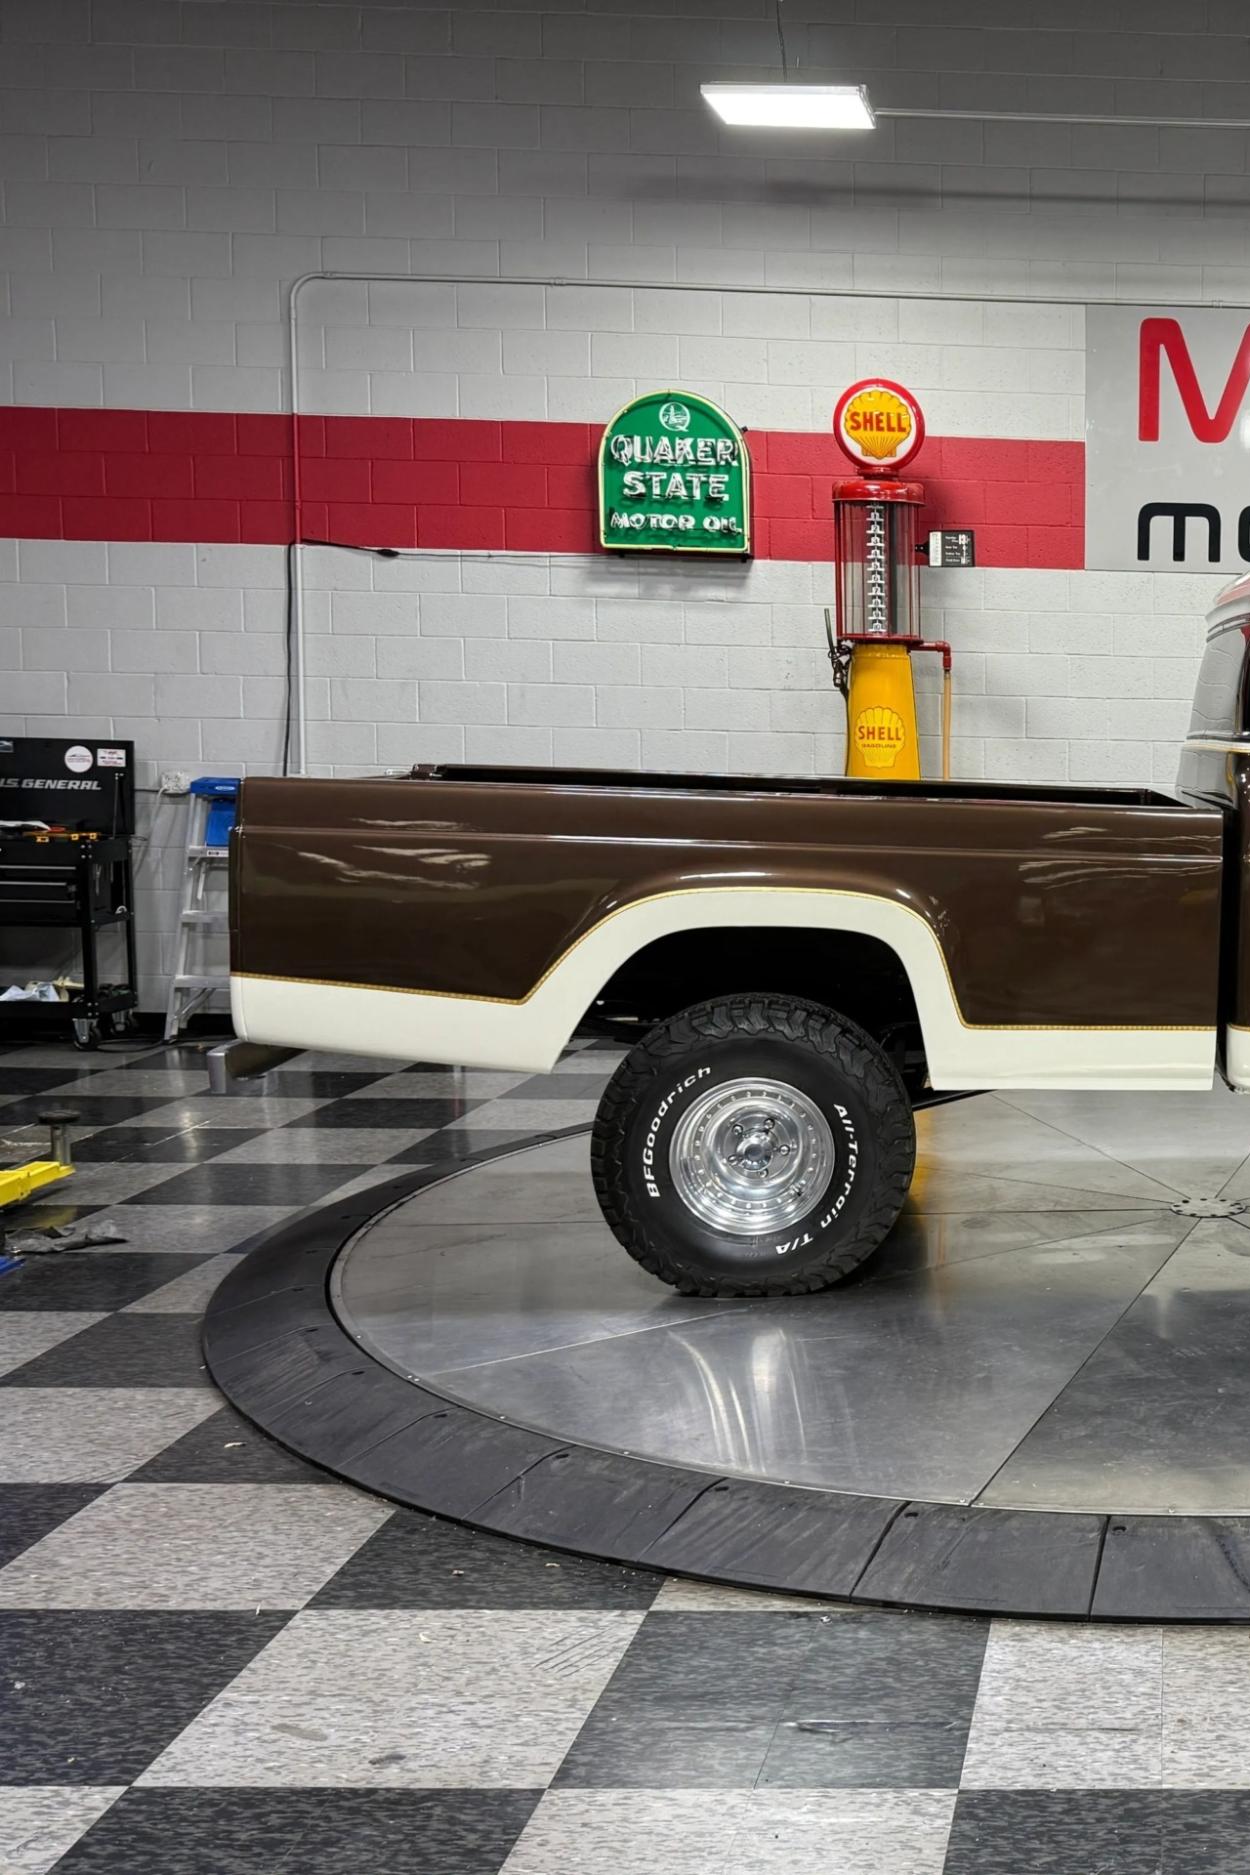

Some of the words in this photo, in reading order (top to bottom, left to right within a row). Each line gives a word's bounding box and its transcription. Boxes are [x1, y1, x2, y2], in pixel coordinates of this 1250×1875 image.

[850, 411, 907, 433] SHELL
[610, 434, 739, 466] QUAKER
[623, 470, 730, 501] STATE
[610, 512, 695, 530] MOTOR
[702, 515, 742, 534] OIL
[858, 726, 901, 741] SHELL
[21, 778, 102, 790] GENERAL
[643, 1066, 711, 1198] BFGoodrich
[820, 1103, 859, 1229] All-Terrain
[776, 1231, 813, 1254] T/A
